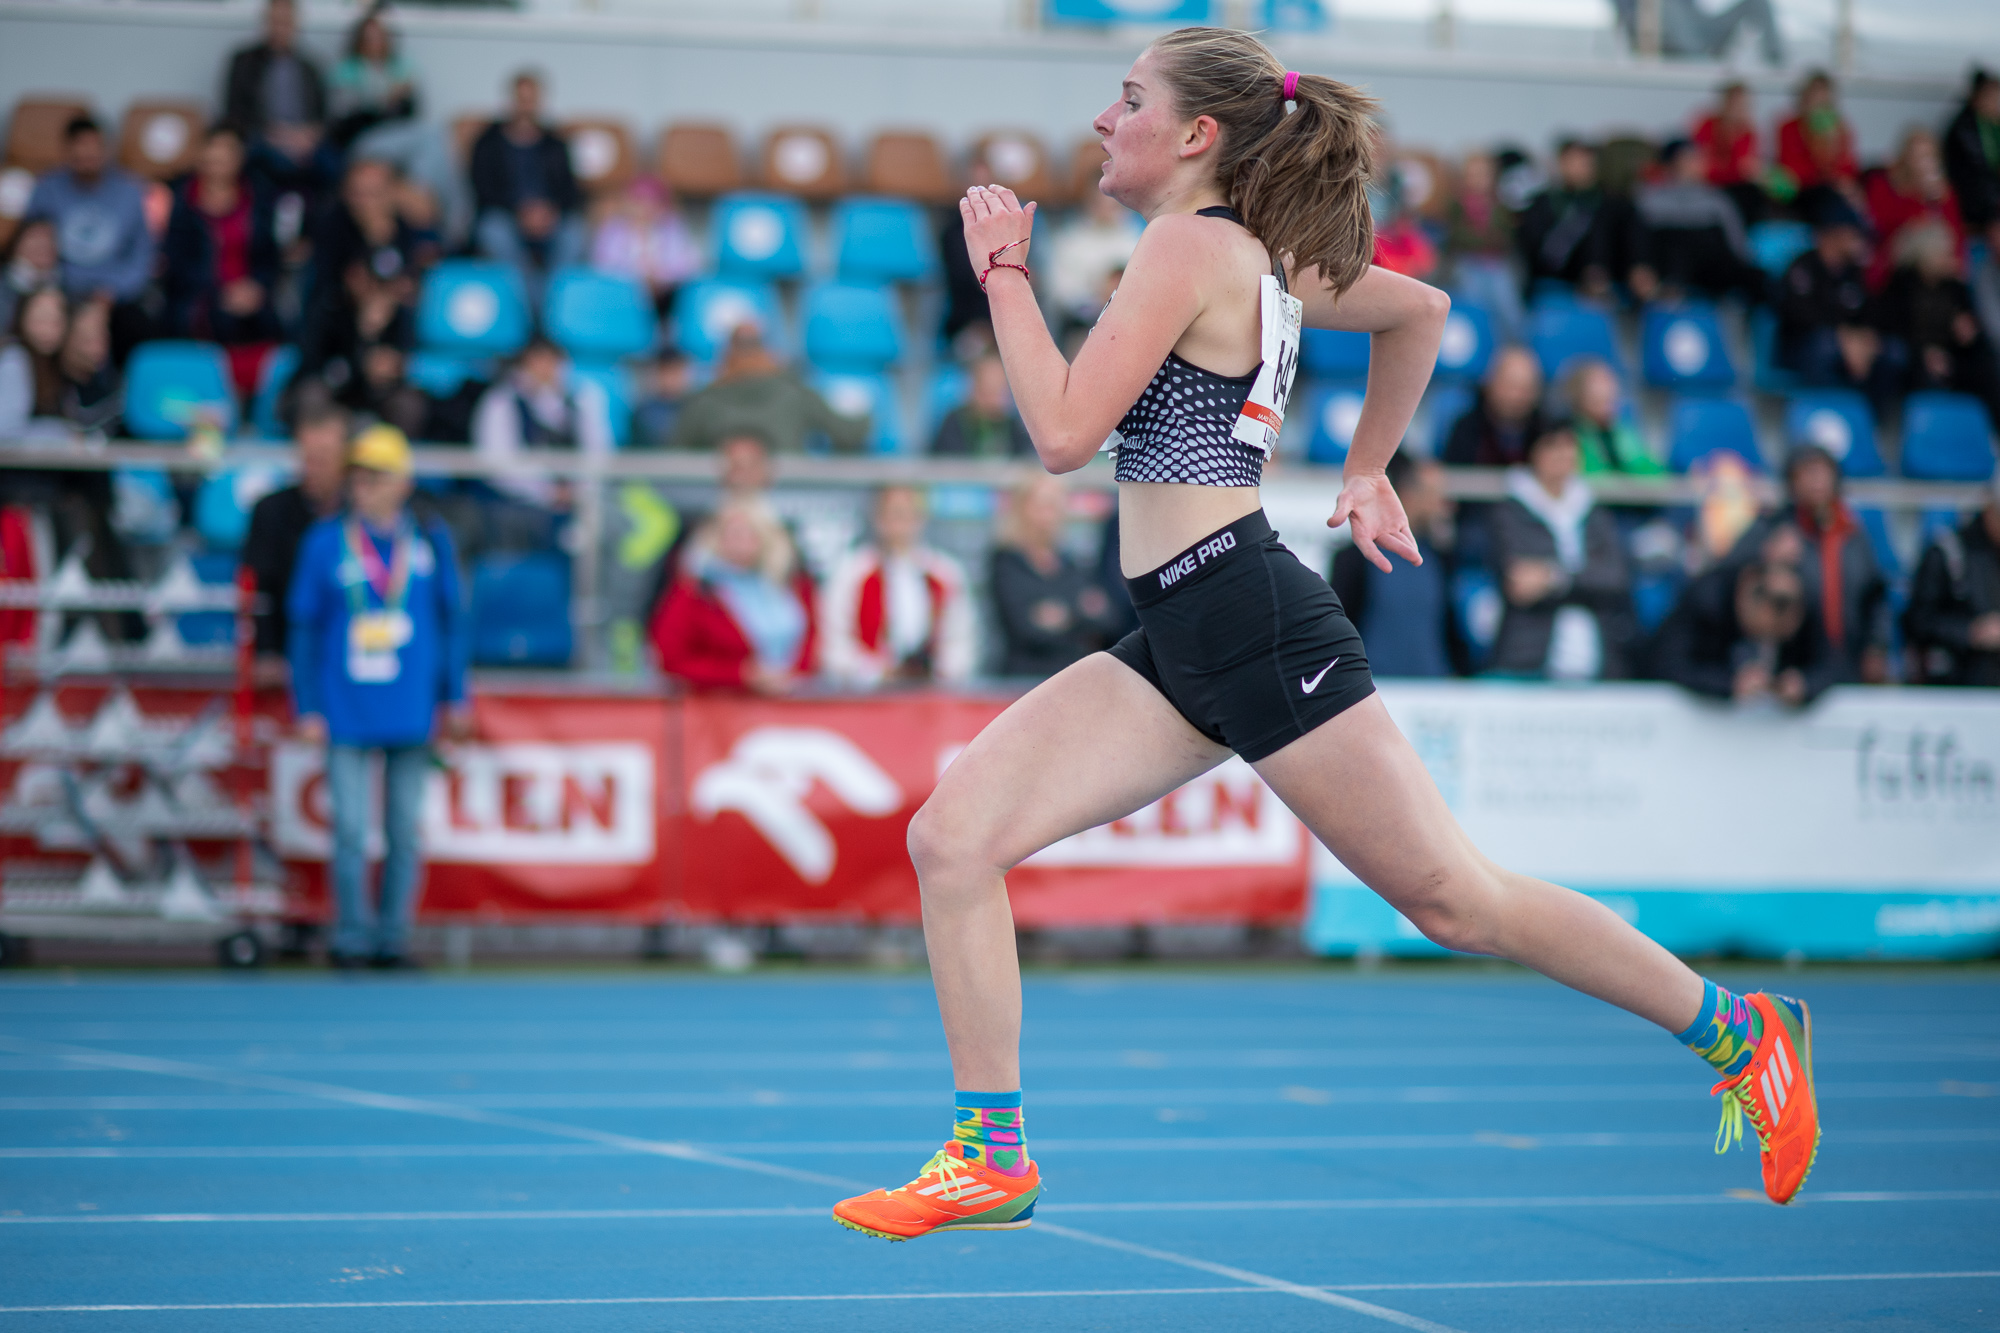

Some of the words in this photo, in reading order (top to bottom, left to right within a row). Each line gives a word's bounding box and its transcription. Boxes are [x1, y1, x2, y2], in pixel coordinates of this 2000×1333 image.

[1159, 553, 1197, 589] NIKE
[1197, 531, 1236, 565] PRO
[297, 768, 616, 834] OLEN
